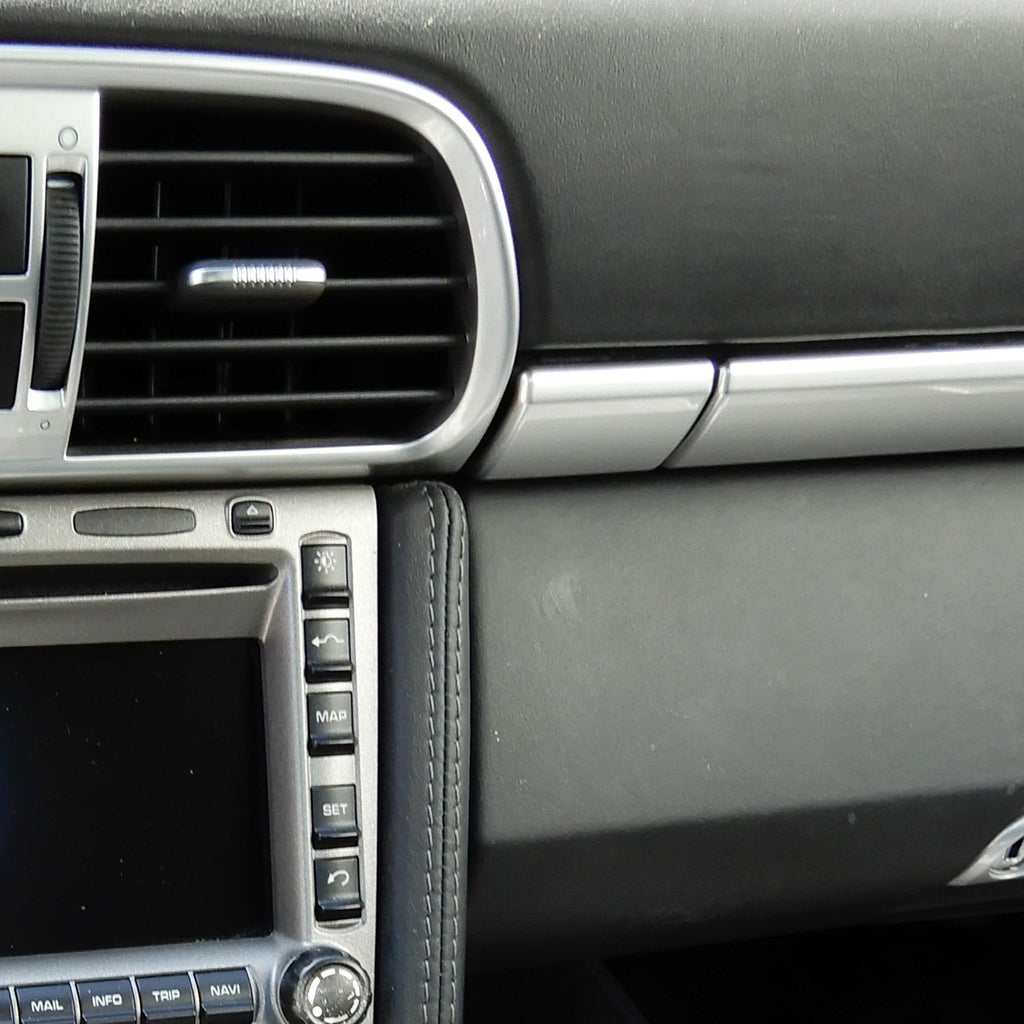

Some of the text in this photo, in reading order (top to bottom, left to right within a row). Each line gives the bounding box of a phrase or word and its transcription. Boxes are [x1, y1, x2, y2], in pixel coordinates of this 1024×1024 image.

[316, 710, 347, 723] MAP
[322, 803, 348, 817] SET
[151, 989, 181, 1003] TRIP
[209, 984, 241, 997] NAVI
[31, 1000, 64, 1012] MAIL
[92, 993, 123, 1008] INFO
